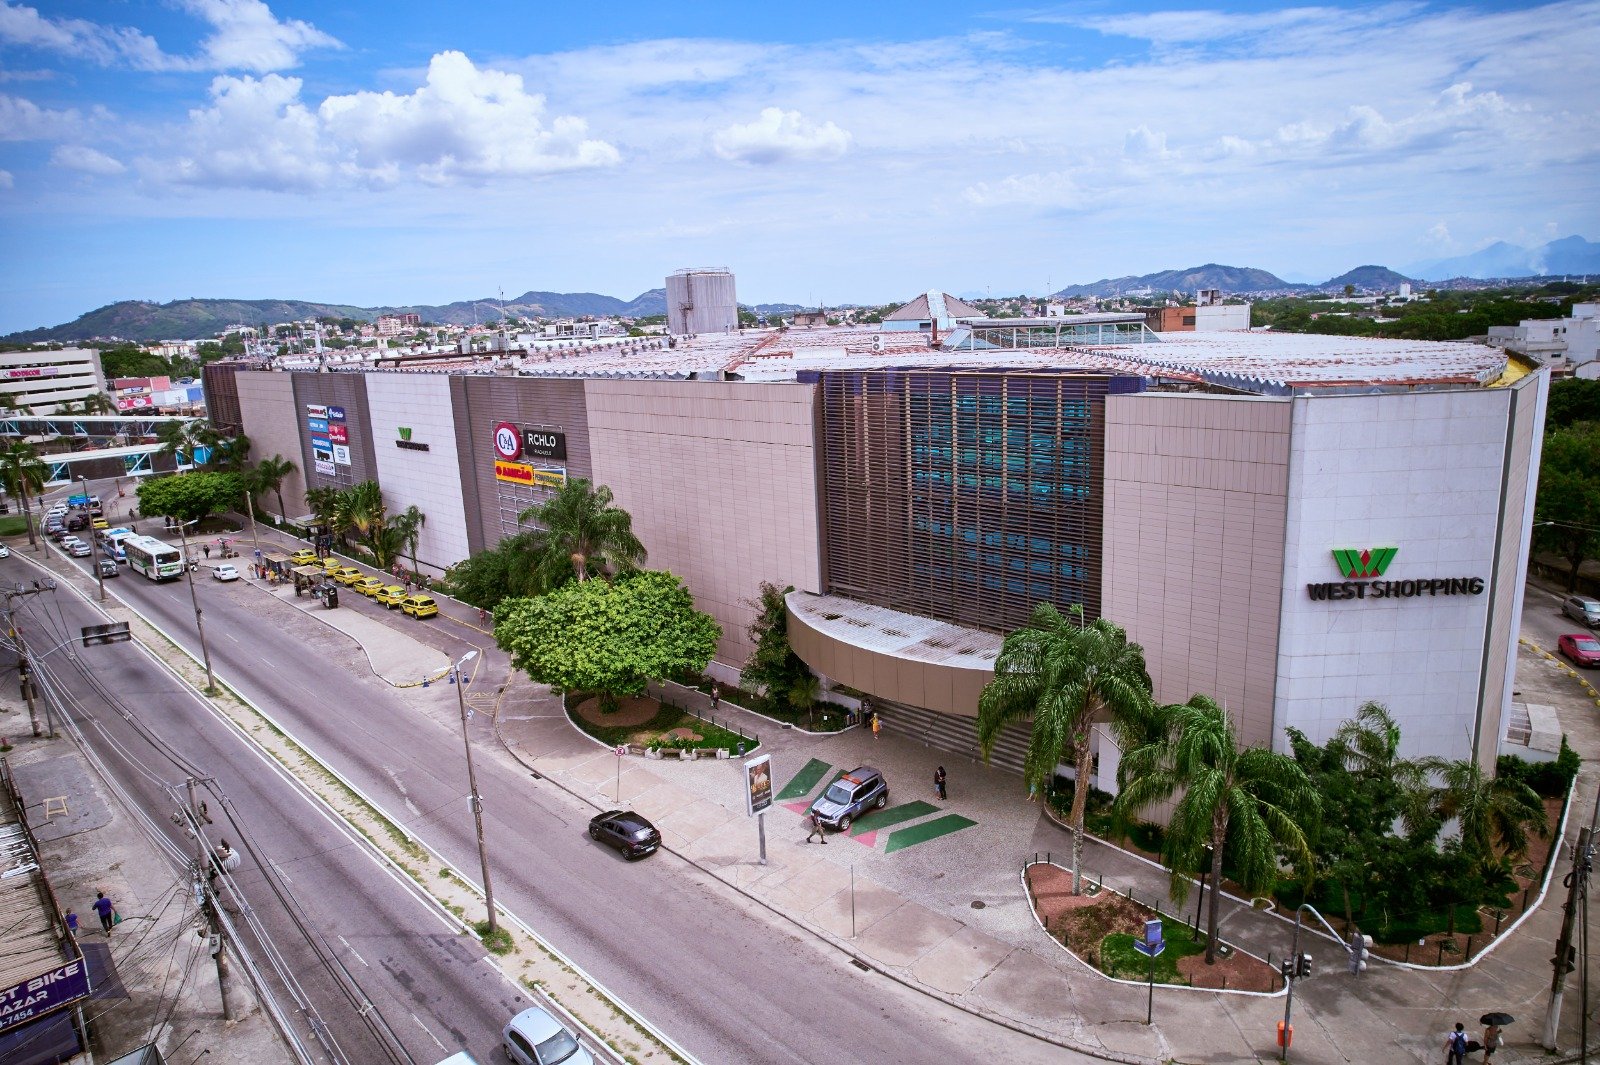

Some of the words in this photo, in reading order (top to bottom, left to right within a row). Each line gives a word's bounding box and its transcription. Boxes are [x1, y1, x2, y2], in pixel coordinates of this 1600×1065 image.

[498, 433, 515, 451] C&A
[528, 433, 556, 448] RCHLO
[1307, 581, 1370, 602] WEST
[1371, 577, 1485, 599] SHOPPING
[27, 963, 80, 993] BIKE
[0, 991, 48, 1016] AZAR
